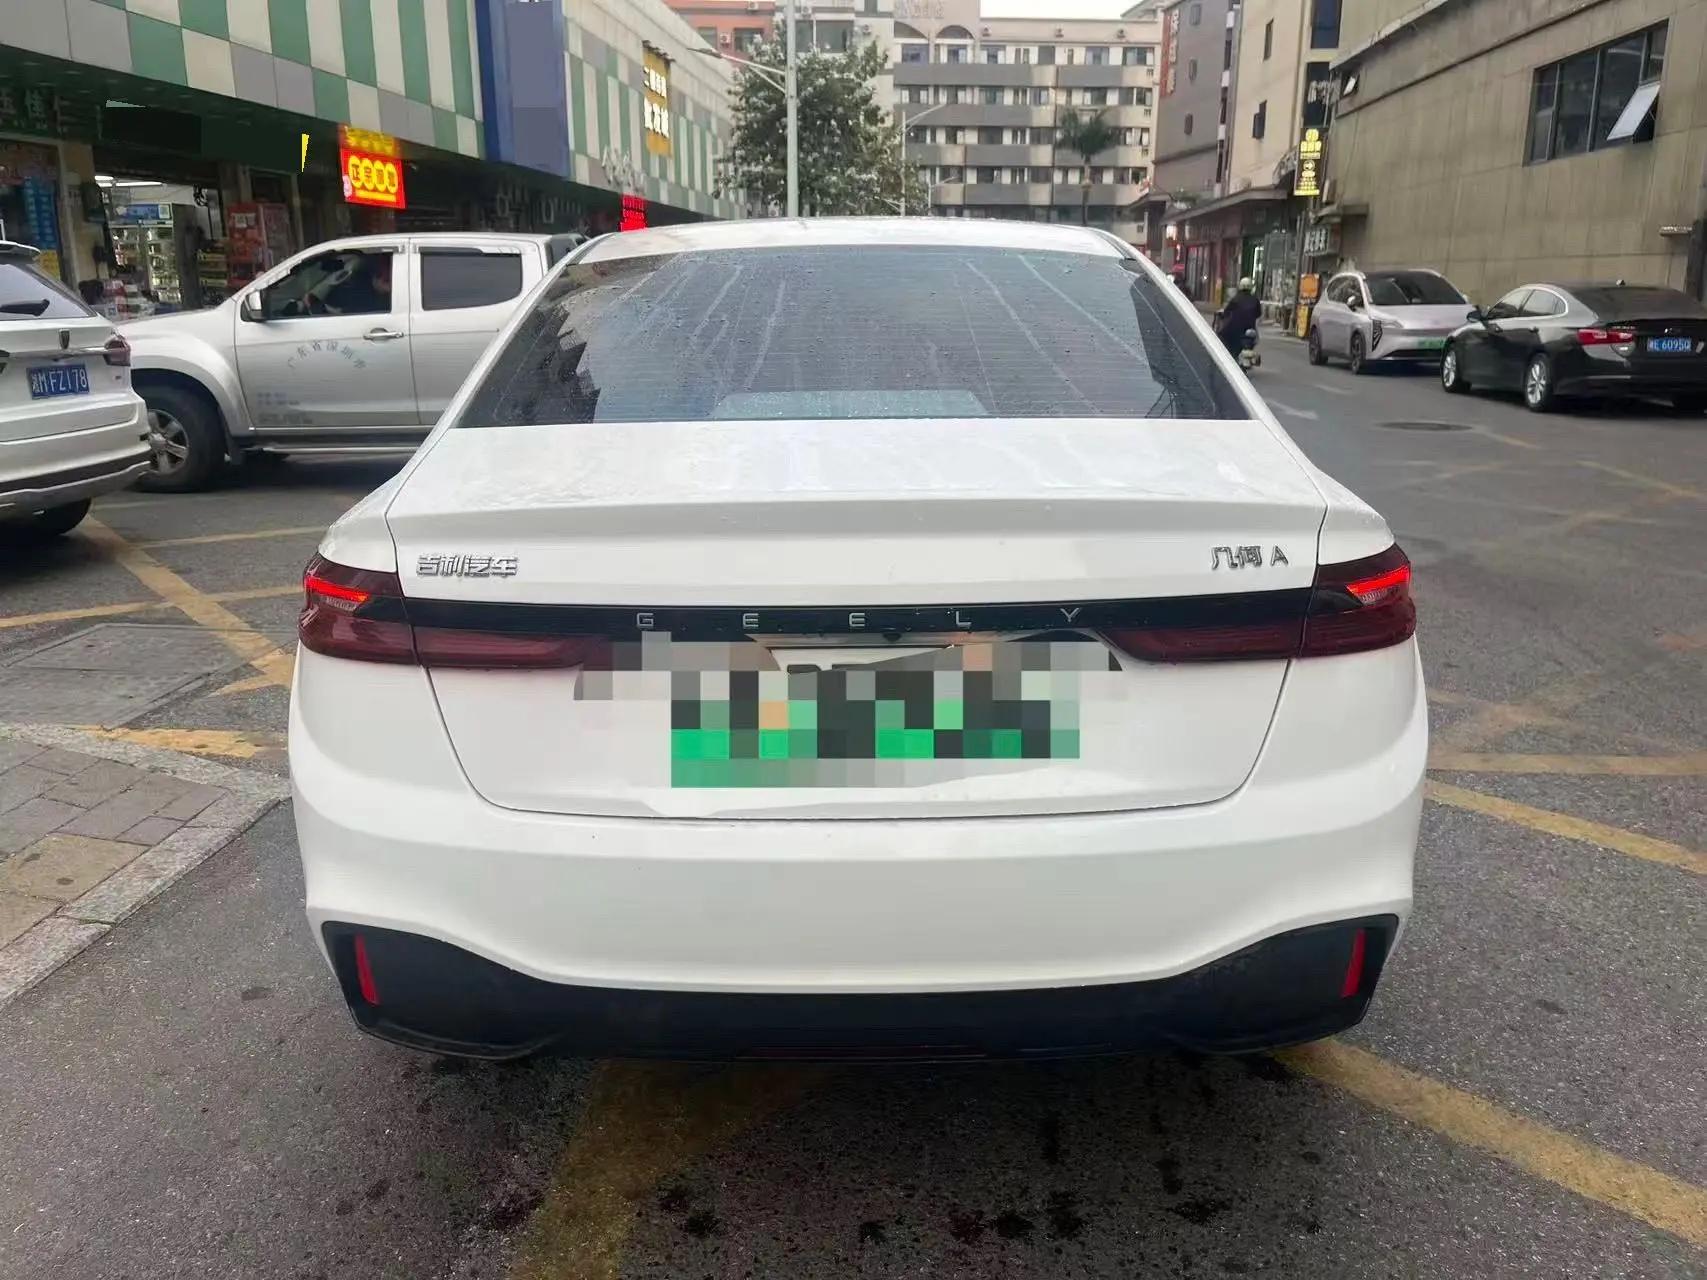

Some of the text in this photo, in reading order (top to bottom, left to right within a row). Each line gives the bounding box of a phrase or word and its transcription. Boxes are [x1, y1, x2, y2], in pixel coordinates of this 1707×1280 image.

[1271, 545, 1289, 566] A
[417, 555, 518, 578] 吉利汽车
[636, 607, 1080, 628] GEELY
